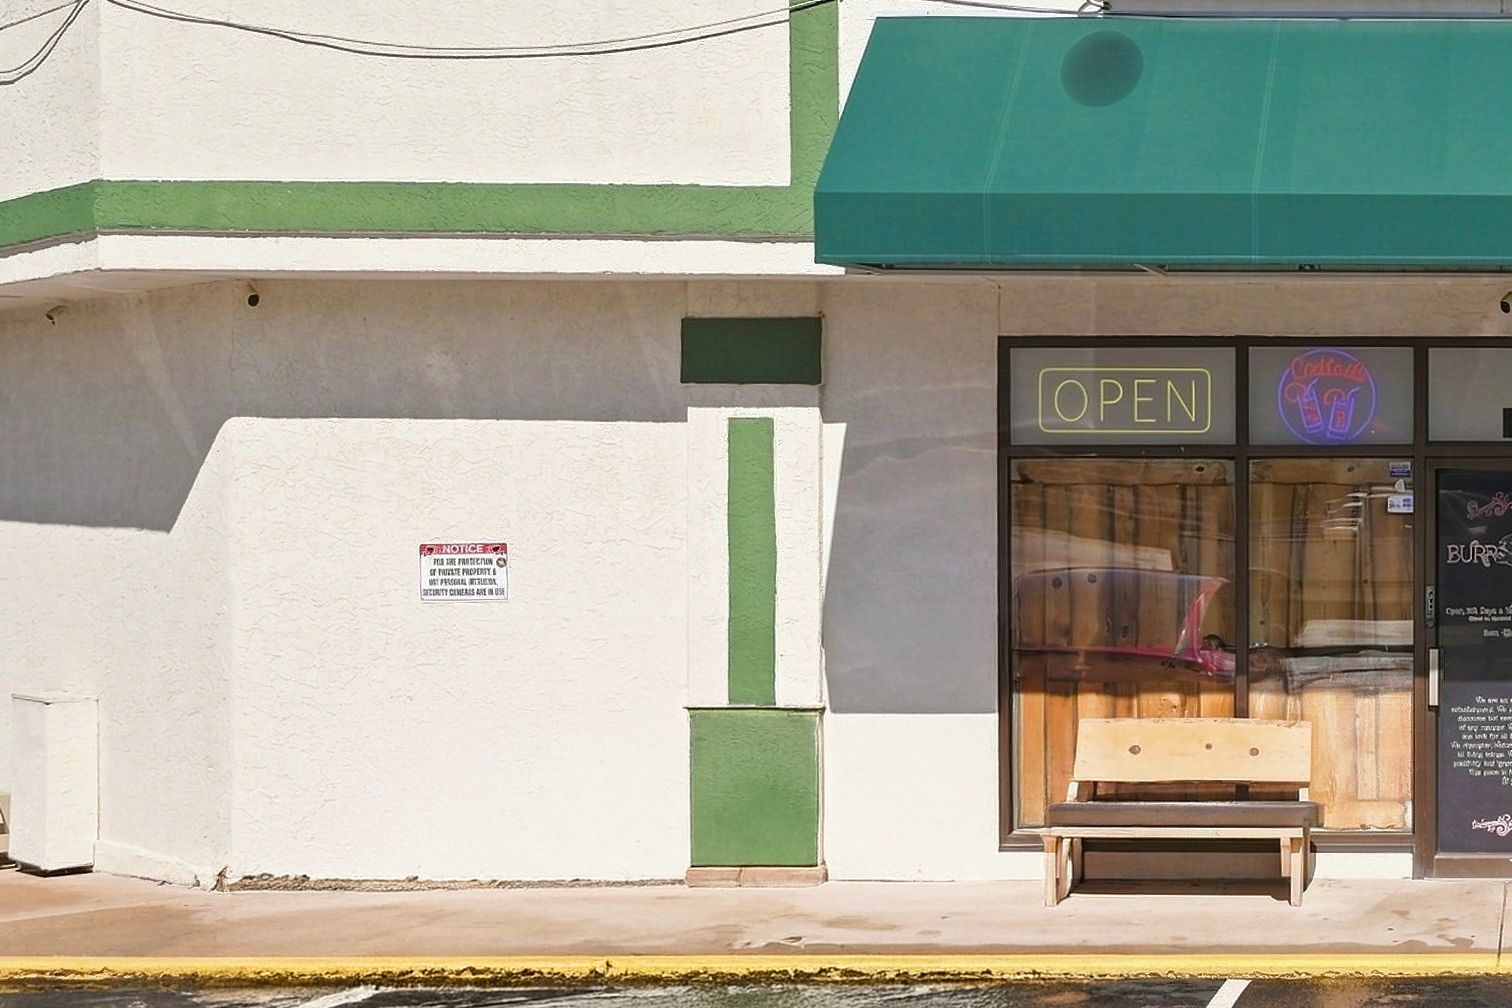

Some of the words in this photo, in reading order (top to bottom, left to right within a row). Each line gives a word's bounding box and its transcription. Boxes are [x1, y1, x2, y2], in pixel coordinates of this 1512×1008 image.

[1054, 379, 1196, 423] OPEN
[442, 544, 484, 554] NOTICE
[433, 557, 446, 566] FOR
[458, 557, 493, 566] PROTECTION
[438, 568, 461, 576] PRIVATE
[462, 568, 490, 576] PROPERTY
